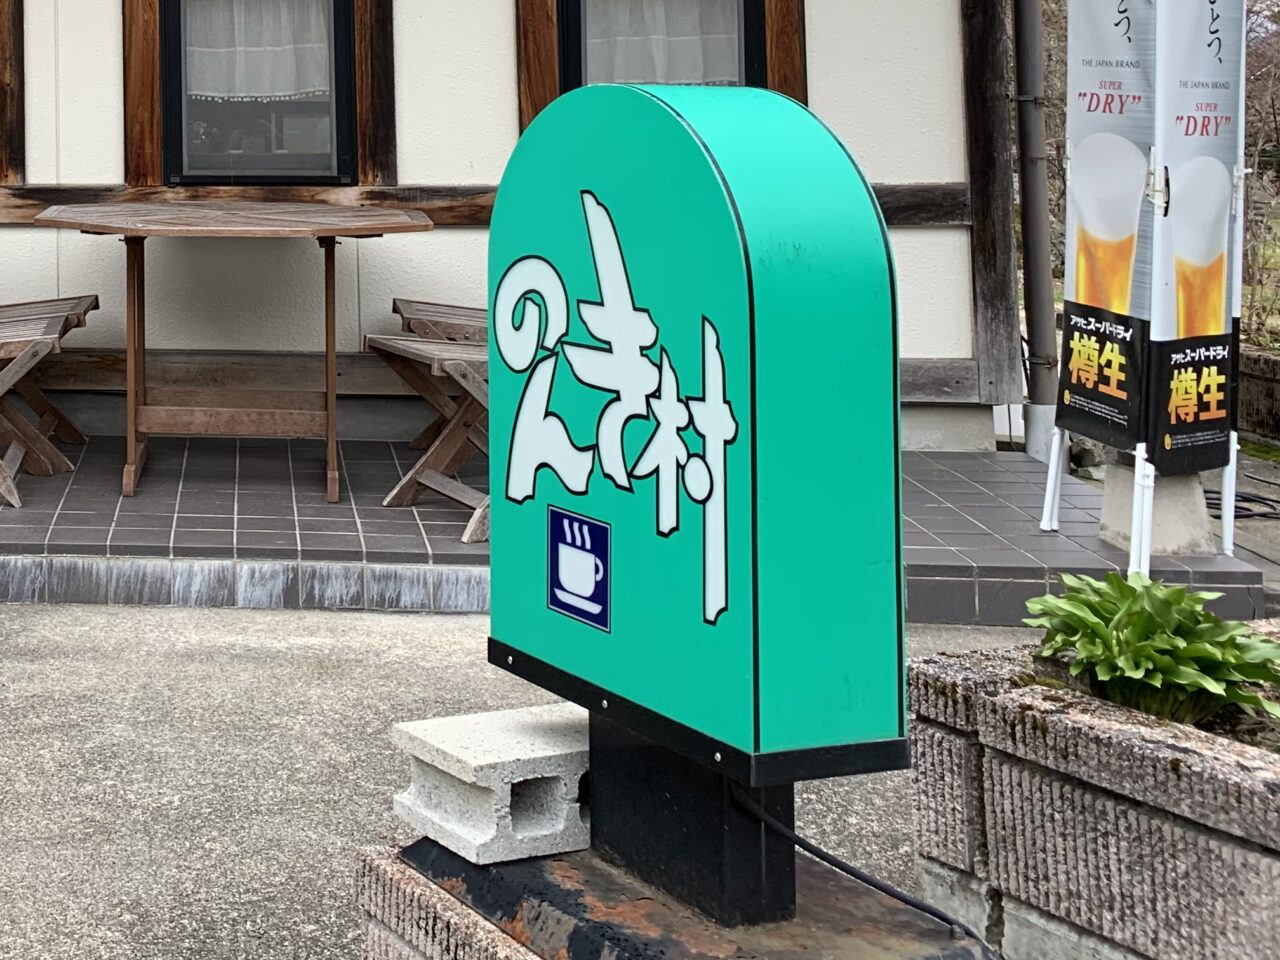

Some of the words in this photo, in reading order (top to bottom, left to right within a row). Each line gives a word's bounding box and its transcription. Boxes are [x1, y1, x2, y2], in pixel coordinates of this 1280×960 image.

[1081, 59, 1094, 68] THE
[1095, 60, 1114, 68] JAPAN
[1115, 60, 1140, 69] BRAND
[1099, 80, 1123, 90] SUPER
[1179, 80, 1189, 89] THE
[1190, 81, 1210, 89] JAPAN
[1211, 81, 1230, 90] BRAND
[1195, 102, 1218, 113] SUPER
[1171, 345, 1229, 365] アサヒスーパードライ
[1068, 331, 1128, 400] 樽生
[1167, 366, 1227, 425] 樽生
